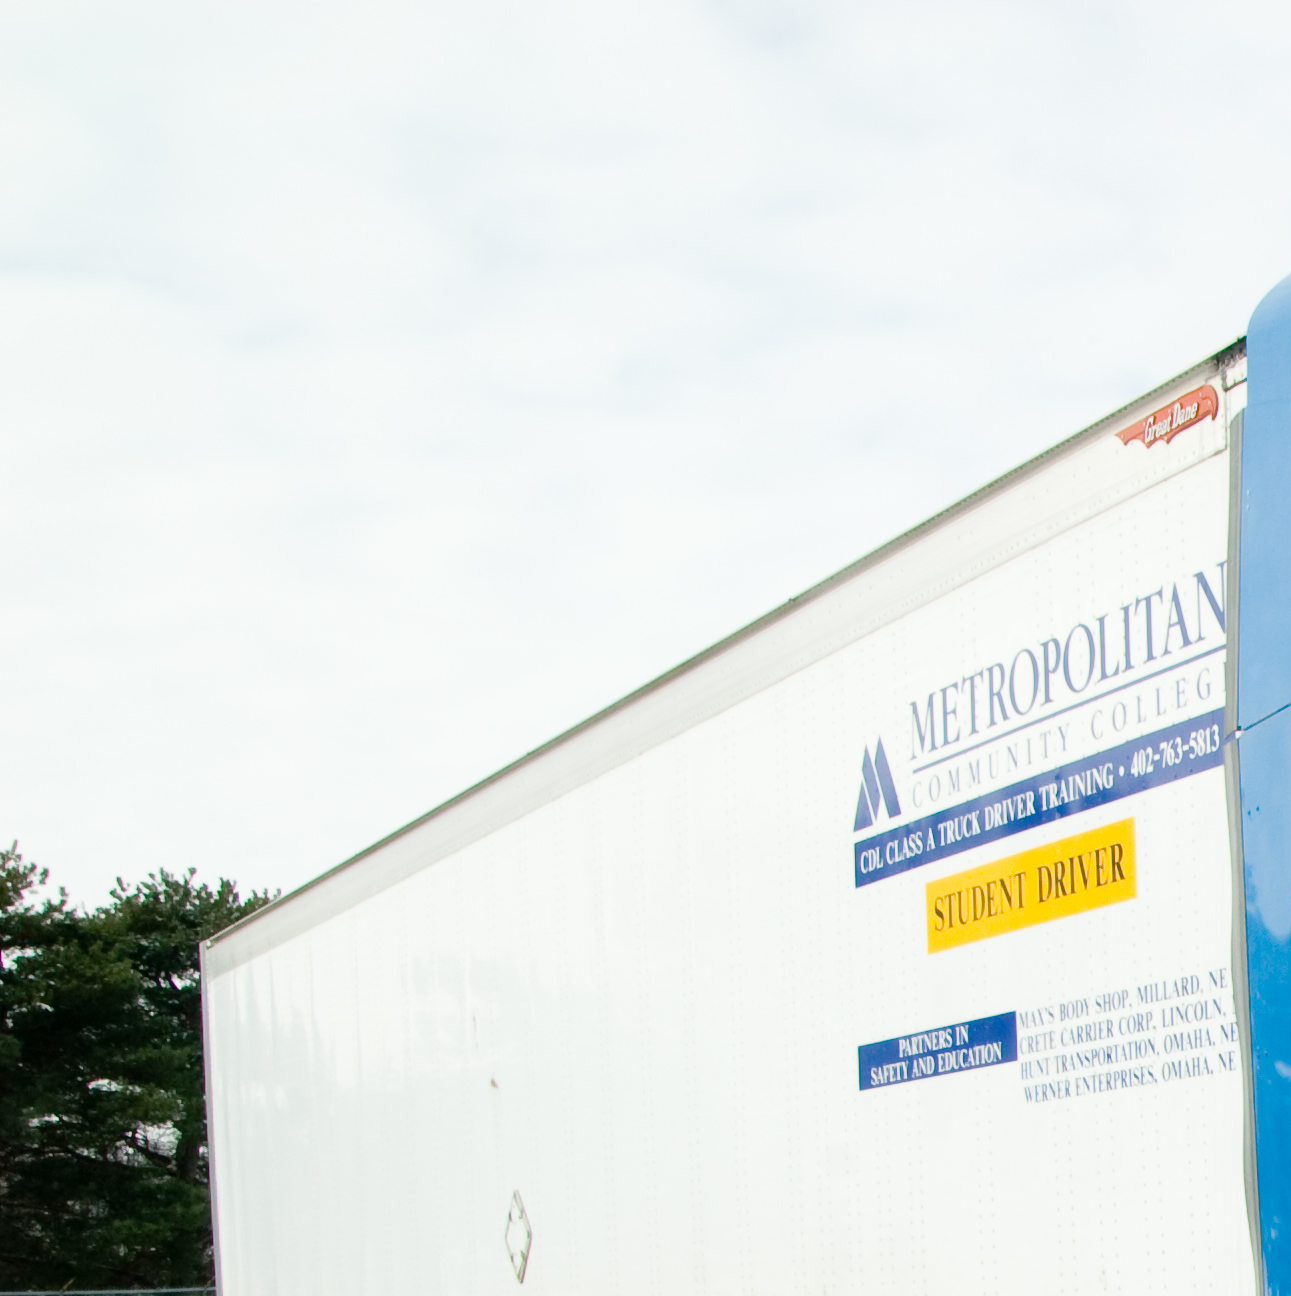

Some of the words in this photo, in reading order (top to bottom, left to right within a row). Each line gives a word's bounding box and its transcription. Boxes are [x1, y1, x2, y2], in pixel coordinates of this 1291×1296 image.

[1144, 412, 1172, 443] Great
[1172, 401, 1199, 429] Dane
[909, 559, 1227, 760] METROPOLITAN
[912, 723, 1070, 808] COMMUNITY
[1091, 662, 1227, 740] COLLEG
[859, 845, 884, 874] CDL
[886, 832, 923, 864] CLASS
[926, 833, 936, 850] A
[938, 816, 981, 844] TRUCK
[984, 793, 1036, 830] DRIVER
[1039, 764, 1115, 812] TRAINING
[1130, 723, 1221, 778] 402-763-5813
[934, 871, 1027, 933] STUDENT
[1037, 842, 1127, 904] DRIVER
[1019, 1005, 1055, 1031] MAX'S
[1059, 998, 1091, 1022] BODY
[1208, 967, 1228, 990] NE
[1019, 1031, 1056, 1055] CRETE
[1060, 1019, 1114, 1047] CARRIER
[1161, 997, 1227, 1028] LINCOLN,
[870, 1062, 909, 1086] SAFETY
[912, 1055, 935, 1078] AND
[938, 1042, 1002, 1073] EDUCATION
[898, 1029, 952, 1058] PARTNERS
[955, 1025, 970, 1046] IN
[1020, 1058, 1050, 1080] HUNT
[1055, 1038, 1159, 1074] TRANSPORTATION,
[1163, 1028, 1216, 1055] OMAHA,
[1220, 1021, 1239, 1044] NE
[1024, 1080, 1071, 1104] WERNER
[1075, 1065, 1158, 1097] ENTERPRISES,
[1162, 1056, 1214, 1082] OMAHA,
[1218, 1050, 1237, 1073] NE
